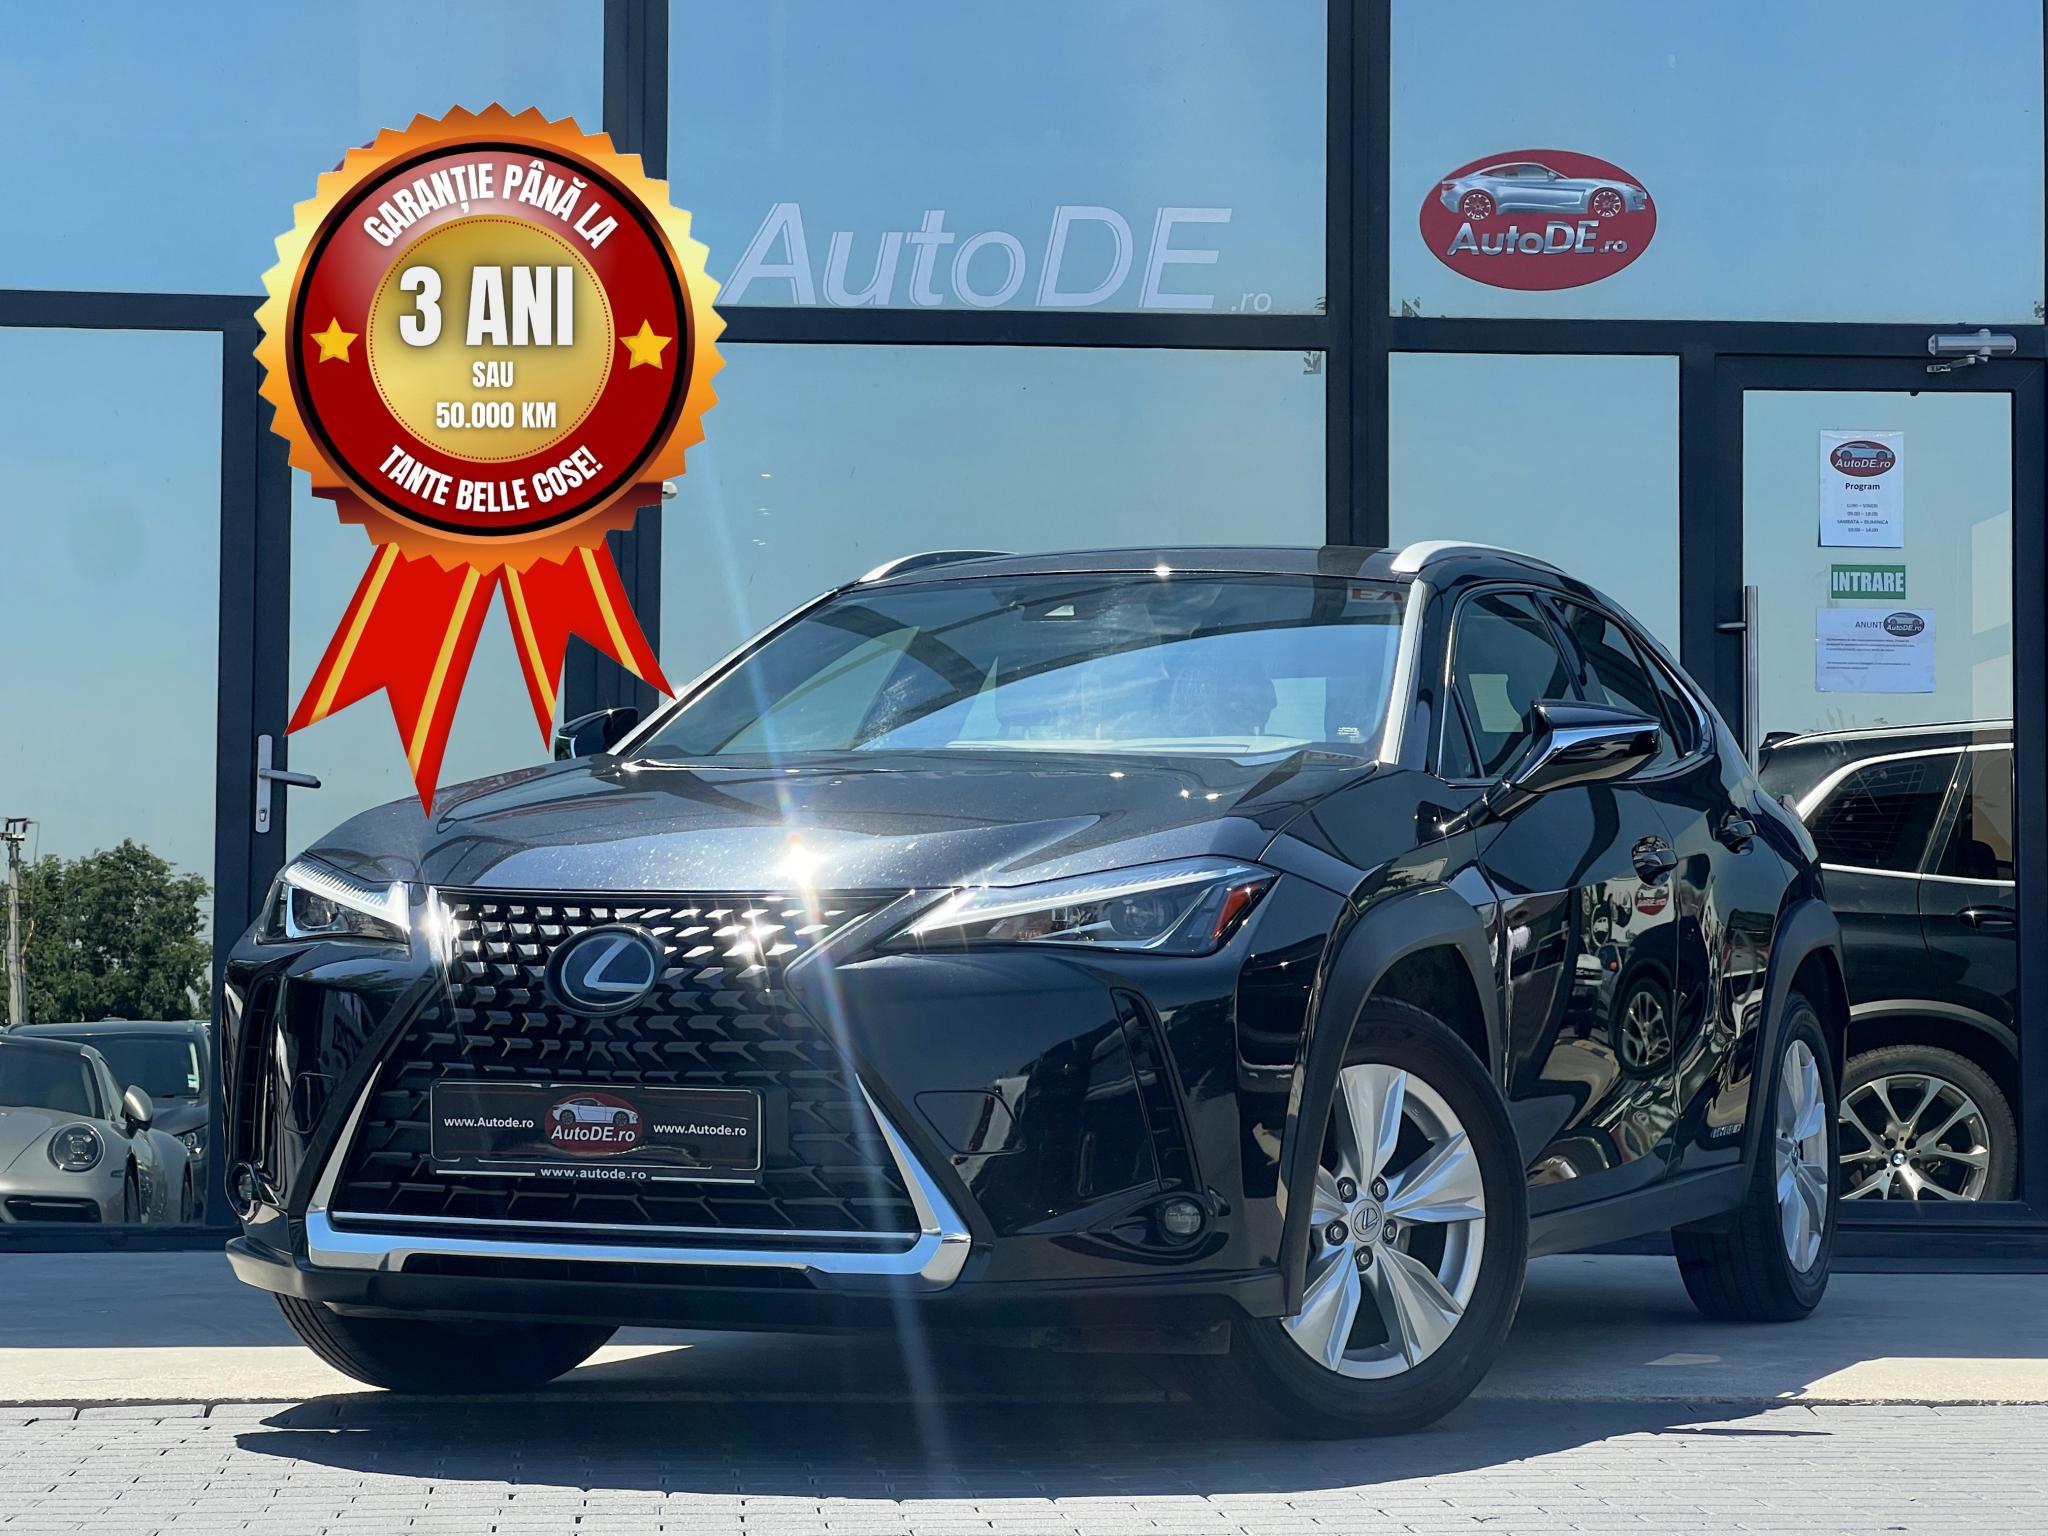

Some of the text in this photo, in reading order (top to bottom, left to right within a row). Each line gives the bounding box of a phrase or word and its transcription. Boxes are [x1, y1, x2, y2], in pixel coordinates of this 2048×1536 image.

[1834, 458, 1892, 470] AutoDE.ro
[1844, 482, 1881, 492] Program
[1832, 571, 1905, 593] INTRARE
[443, 1116, 534, 1129] www.Autode.ro
[550, 1124, 636, 1143] AutoDE.ro
[653, 1123, 747, 1137] www.Autode.ro
[540, 1166, 647, 1180] www.autode.ro
